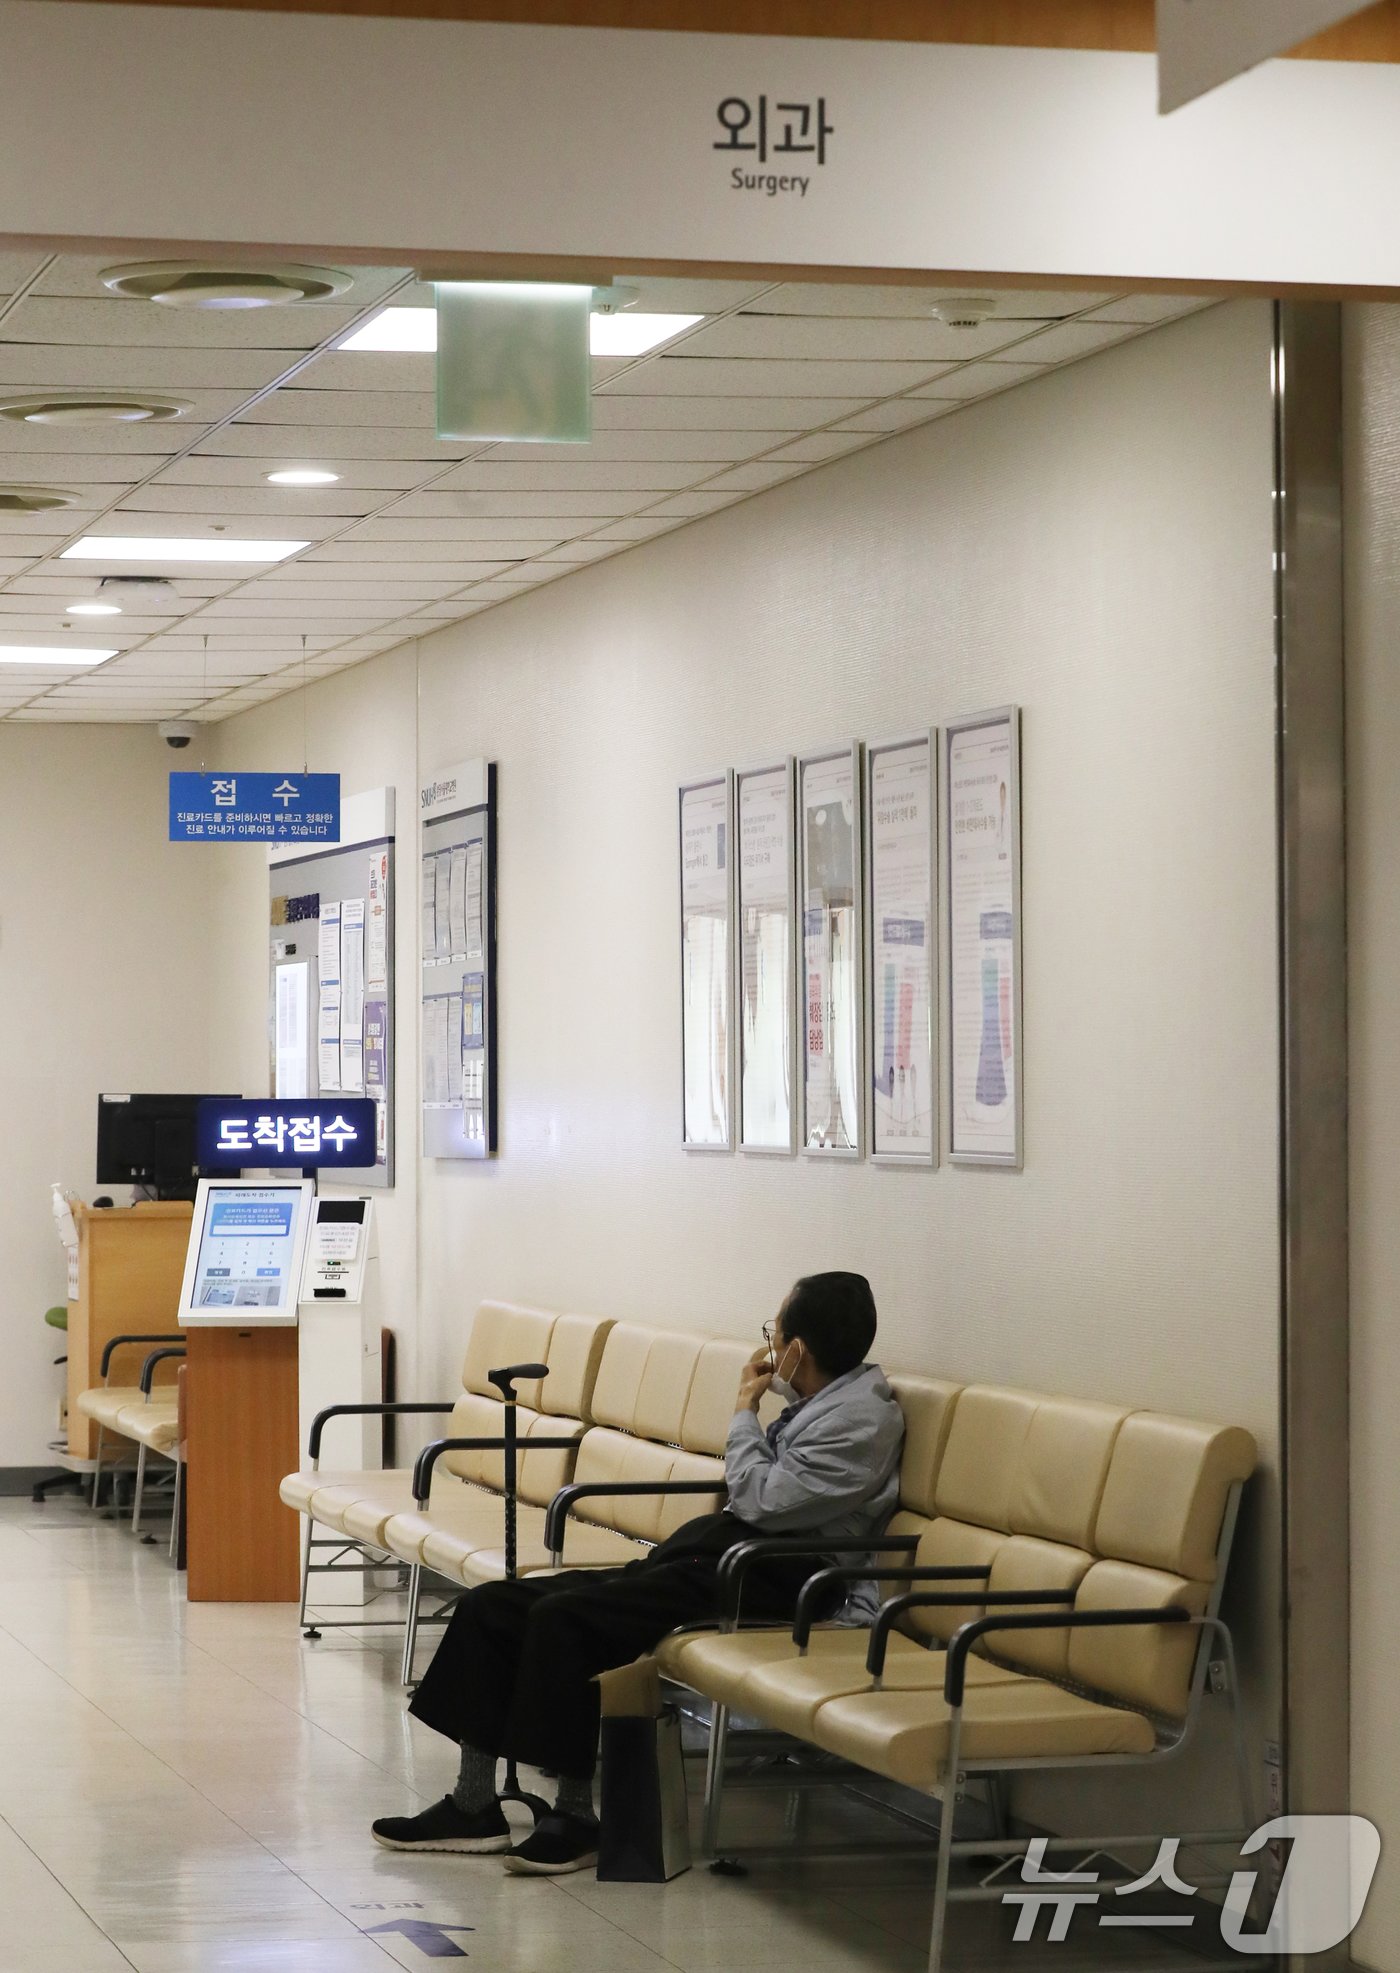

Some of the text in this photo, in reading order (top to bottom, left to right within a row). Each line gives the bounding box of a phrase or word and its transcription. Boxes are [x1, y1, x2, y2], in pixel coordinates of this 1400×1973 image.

[713, 95, 834, 165] 외과
[731, 167, 809, 197] Surgery
[176, 812, 333, 824] 진료카드를 준비하시면 빠르고 정확한
[185, 825, 328, 836] 진료 안내가 이루어질 수 있습니다
[216, 1115, 358, 1152] 도착접수
